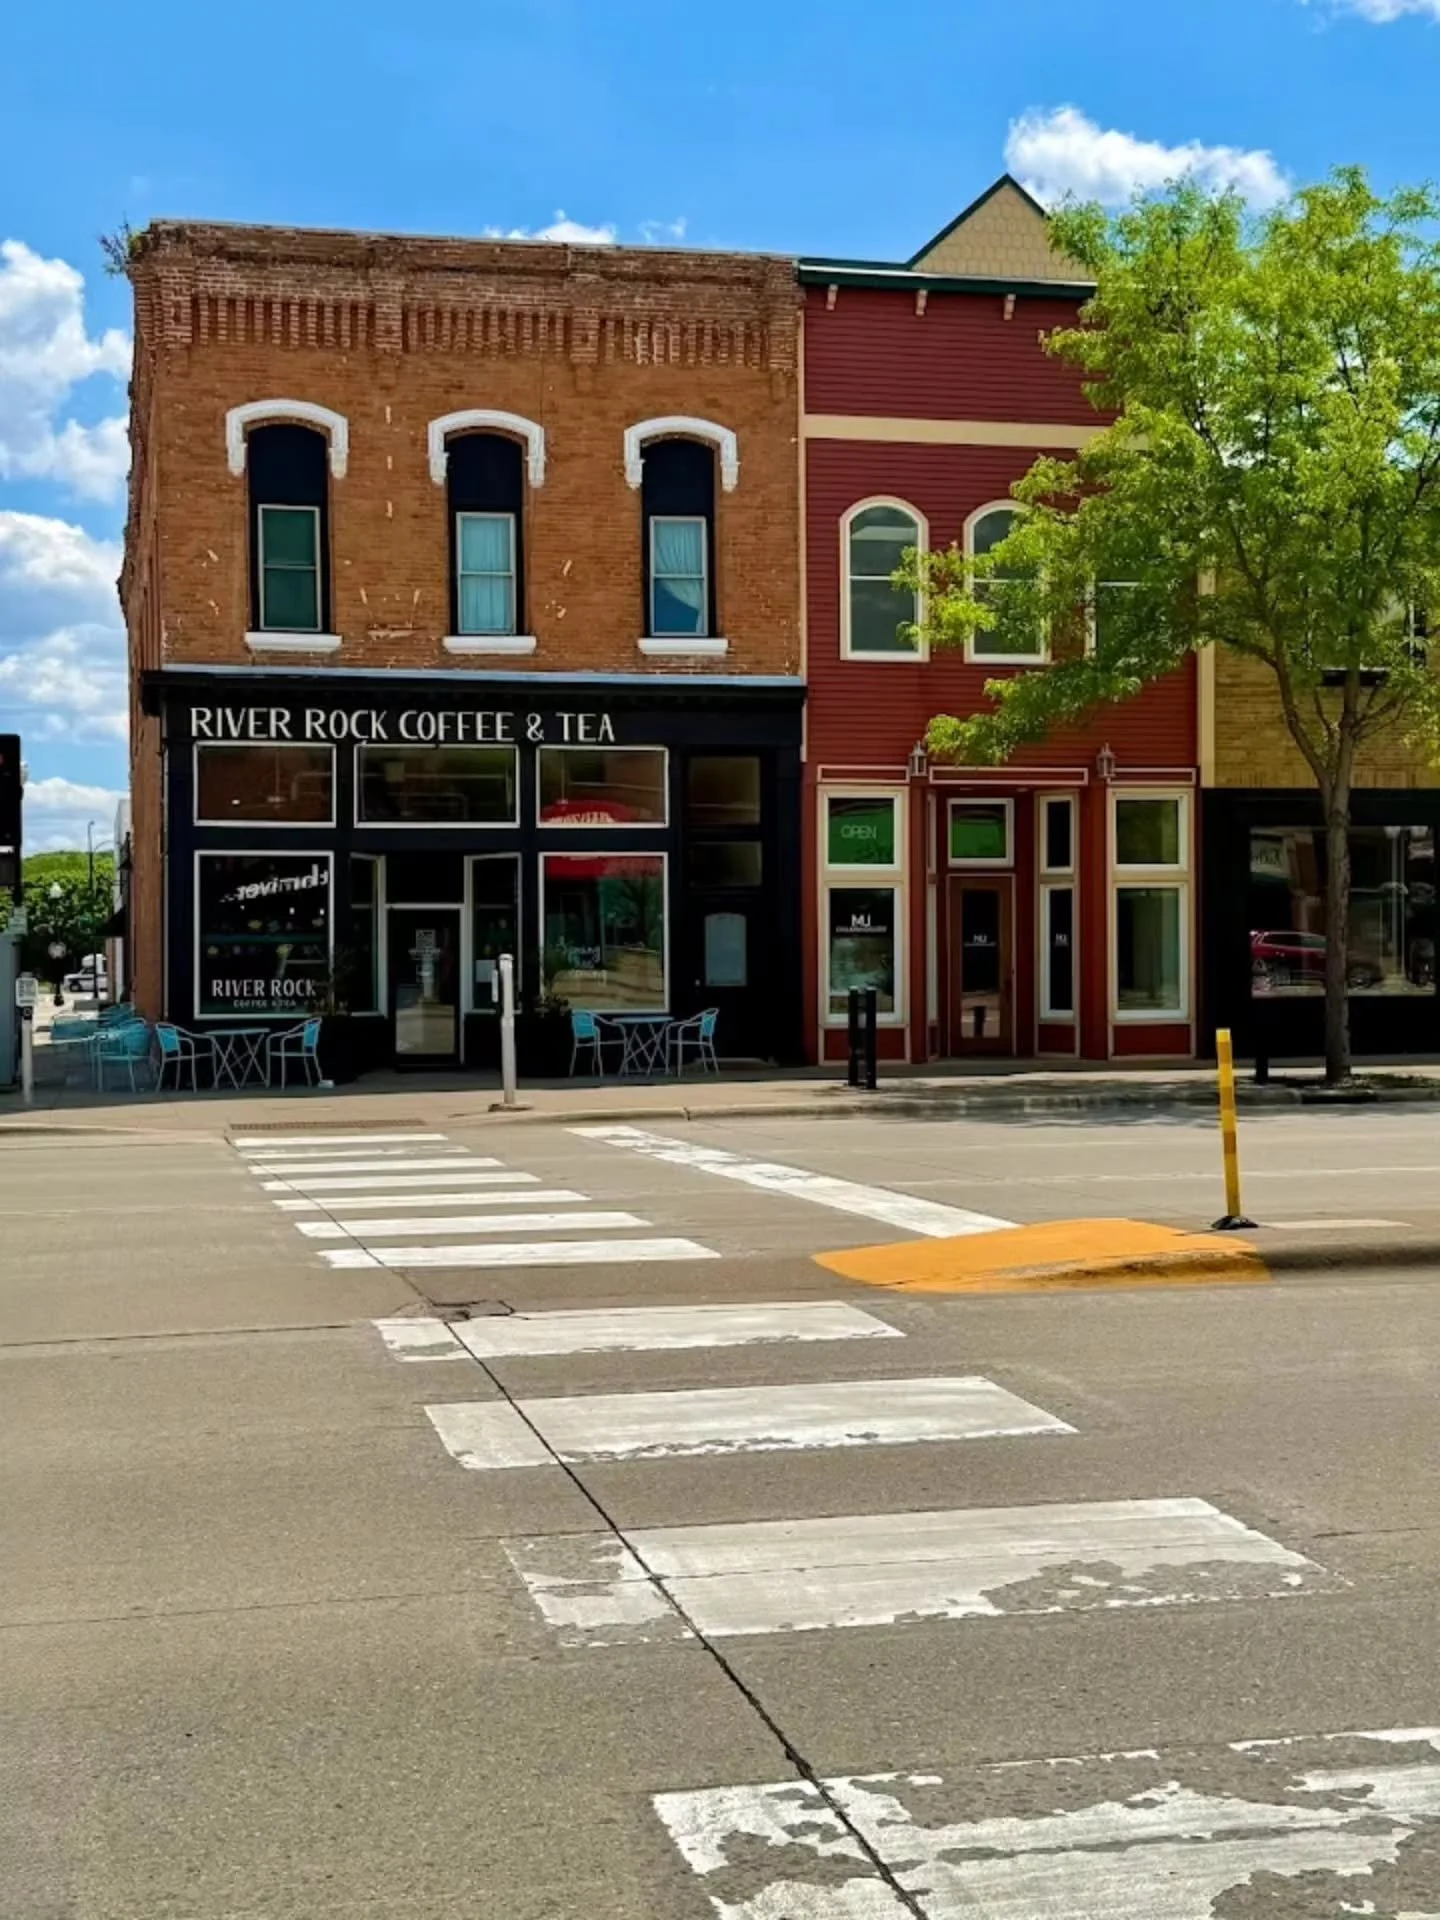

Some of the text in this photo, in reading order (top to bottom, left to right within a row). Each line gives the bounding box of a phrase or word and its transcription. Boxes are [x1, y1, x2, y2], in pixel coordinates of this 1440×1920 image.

[190, 707, 615, 742] RIVER ROCK COFFEE & TEA
[211, 978, 316, 997] RIVER ROCK
